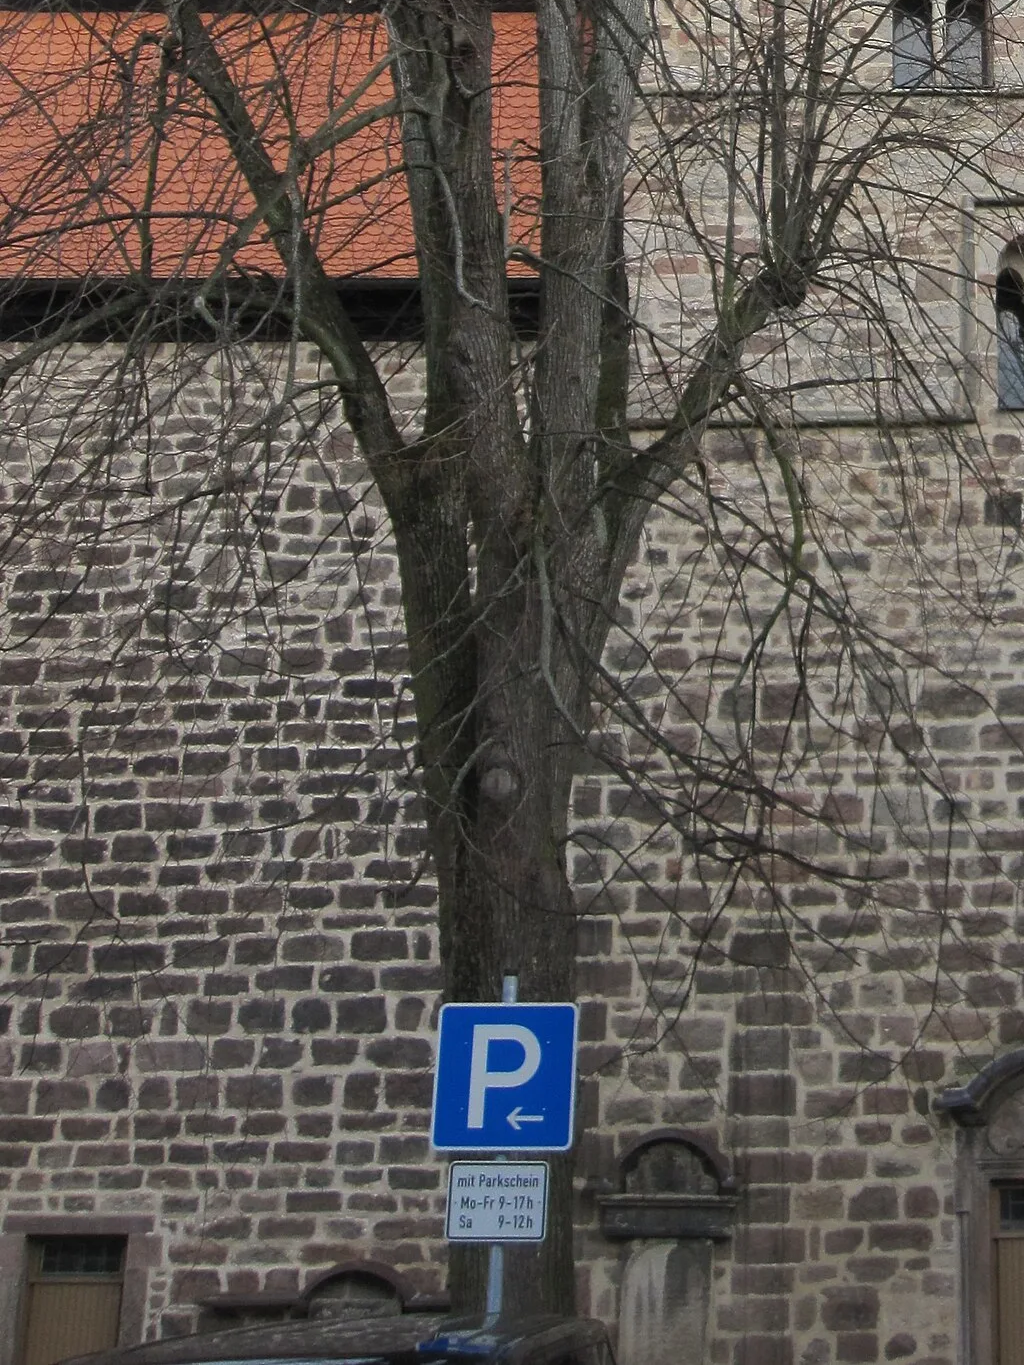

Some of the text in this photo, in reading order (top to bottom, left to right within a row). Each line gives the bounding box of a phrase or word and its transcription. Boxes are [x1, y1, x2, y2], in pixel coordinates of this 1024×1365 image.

[466, 1023, 542, 1130] P
[457, 1173, 539, 1187] mit Parkschein
[460, 1195, 495, 1209] Mo-Fr
[459, 1214, 473, 1229] Sa
